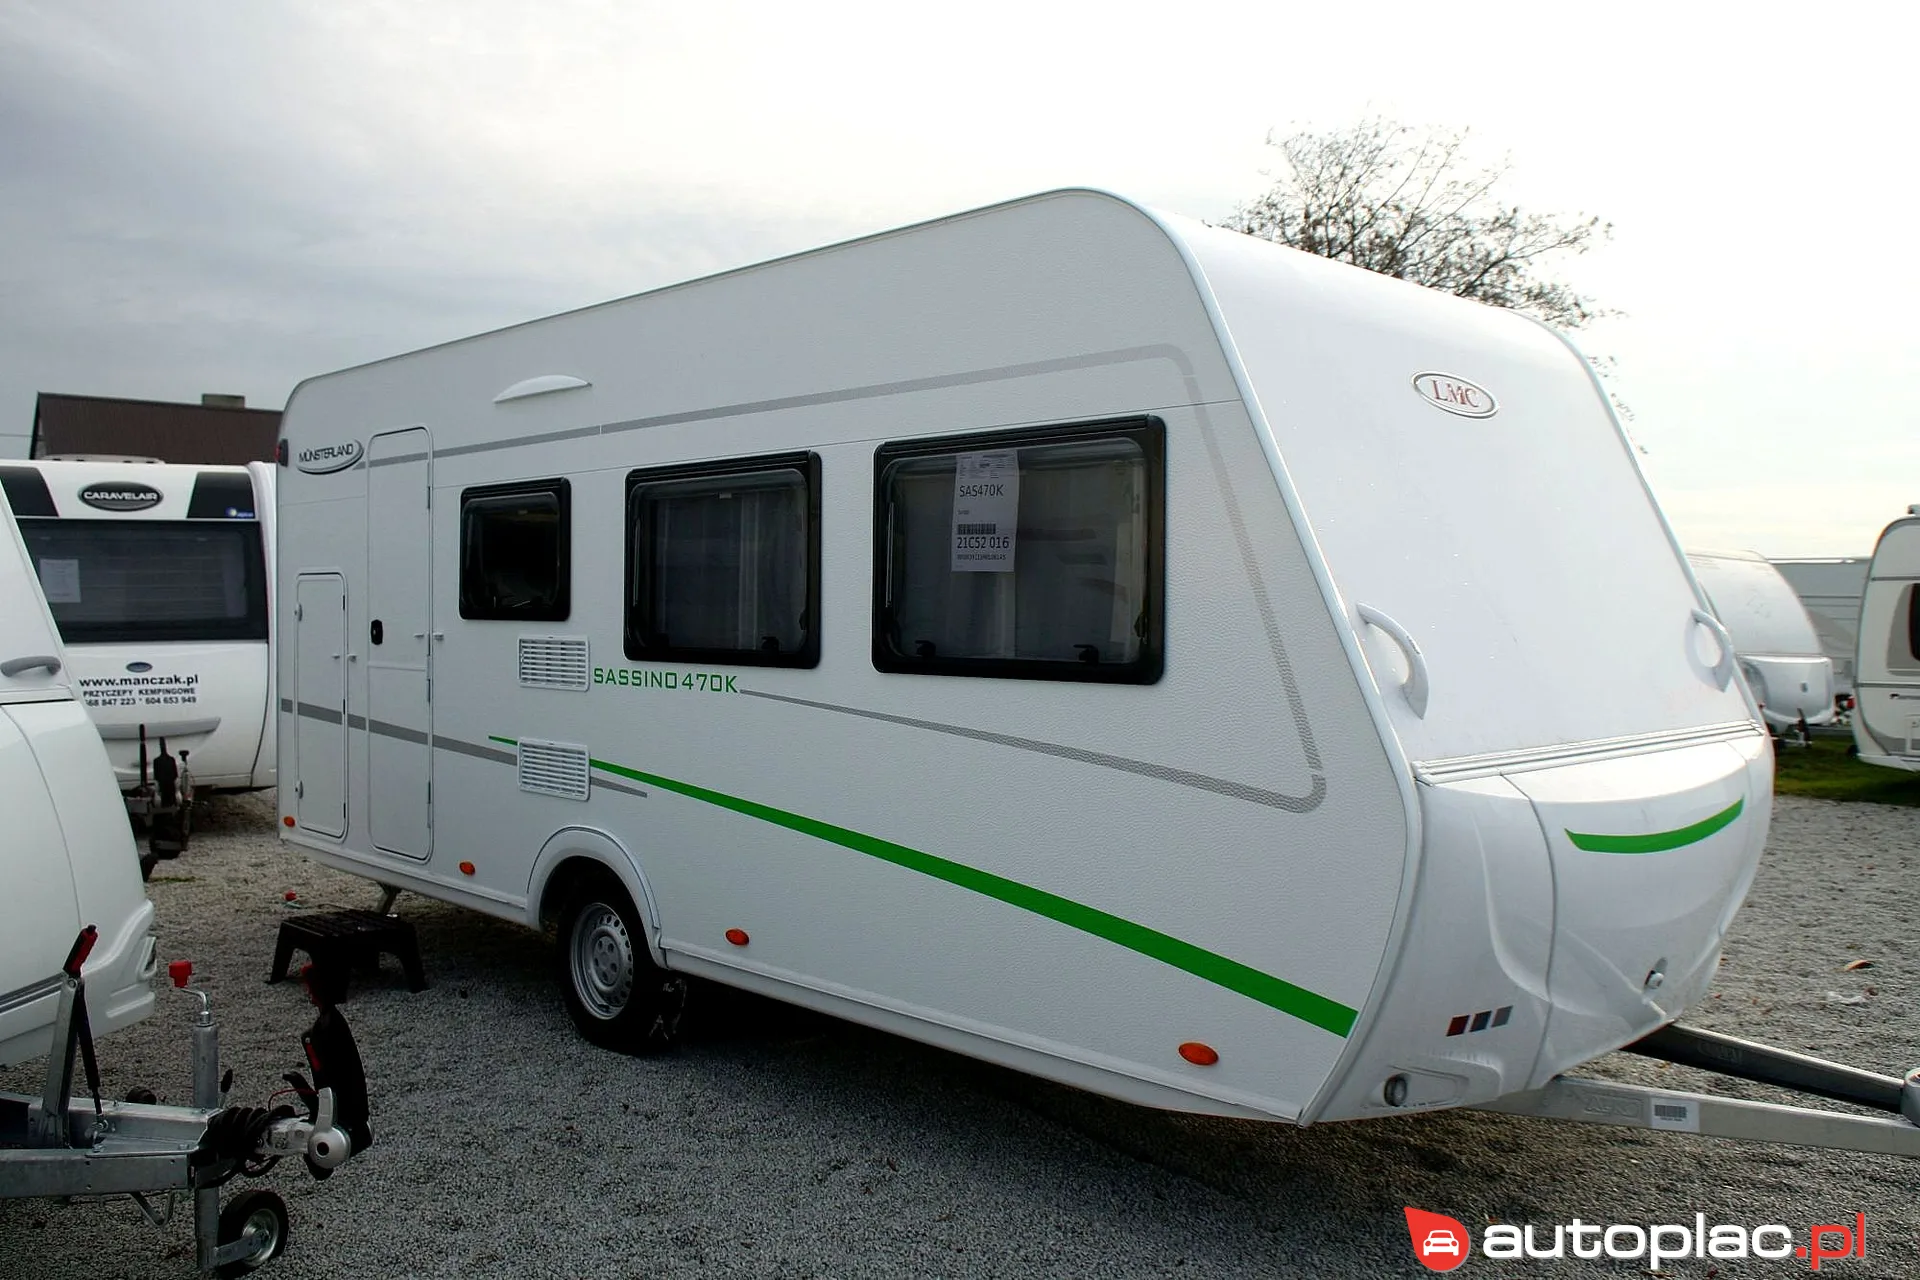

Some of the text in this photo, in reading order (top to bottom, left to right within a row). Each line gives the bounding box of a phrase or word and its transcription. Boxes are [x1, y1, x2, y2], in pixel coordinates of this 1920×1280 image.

[1431, 379, 1481, 408] LMC
[83, 491, 158, 500] CARAVELAIR
[959, 484, 1004, 498] SAS470K
[989, 536, 1010, 549] 016
[79, 674, 198, 687] www.manczak.pl
[594, 667, 738, 694] SASSINO 470K
[83, 687, 196, 698] PRZYCZEPY KEMPINGOWE
[120, 697, 136, 706] 223
